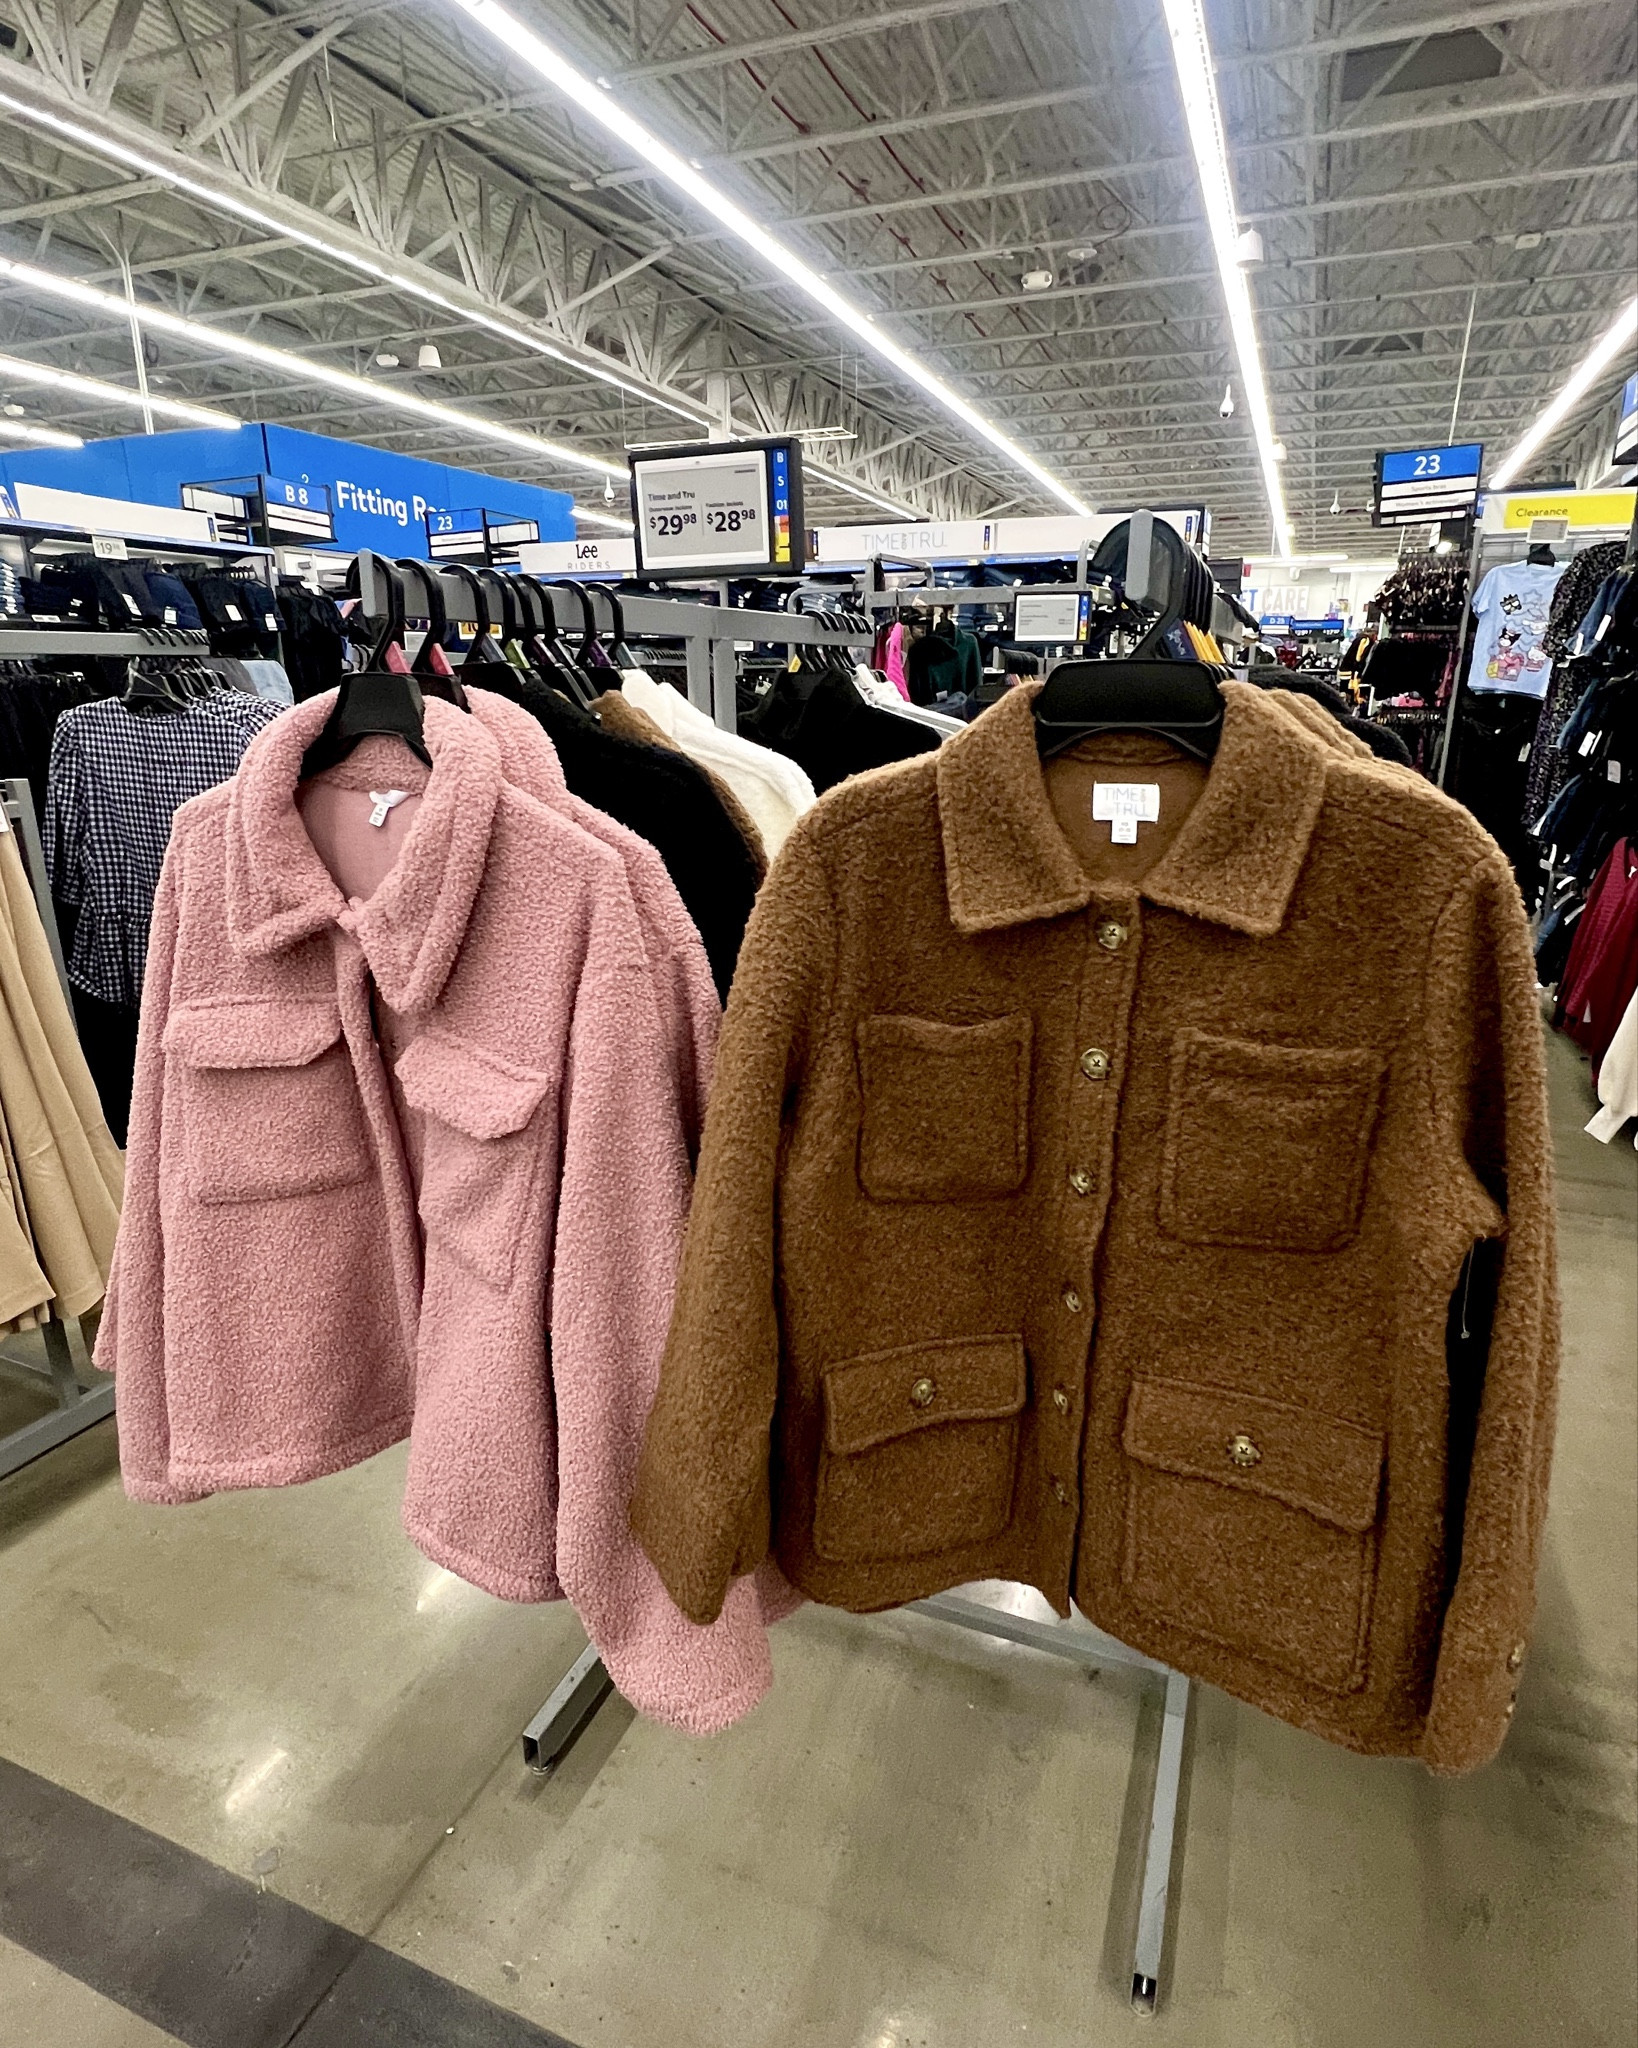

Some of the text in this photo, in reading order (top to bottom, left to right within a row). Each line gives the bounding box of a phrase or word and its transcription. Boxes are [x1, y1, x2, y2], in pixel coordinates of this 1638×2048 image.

[777, 452, 784, 463] B
[1413, 454, 1441, 476] 23
[777, 476, 784, 486] S
[285, 484, 308, 505] B 8
[667, 491, 681, 500] and
[682, 490, 695, 499] Tru
[336, 480, 408, 527] Fitting
[1516, 507, 1568, 517] Clearance
[437, 515, 453, 531] 23
[862, 533, 900, 551] TIME
[908, 531, 947, 549] TRU
[576, 544, 598, 559] Lee
[567, 561, 611, 570] RIDERS
[1262, 588, 1307, 612] CARE
[1103, 787, 1139, 802] TIME
[1113, 801, 1149, 817] TRU
